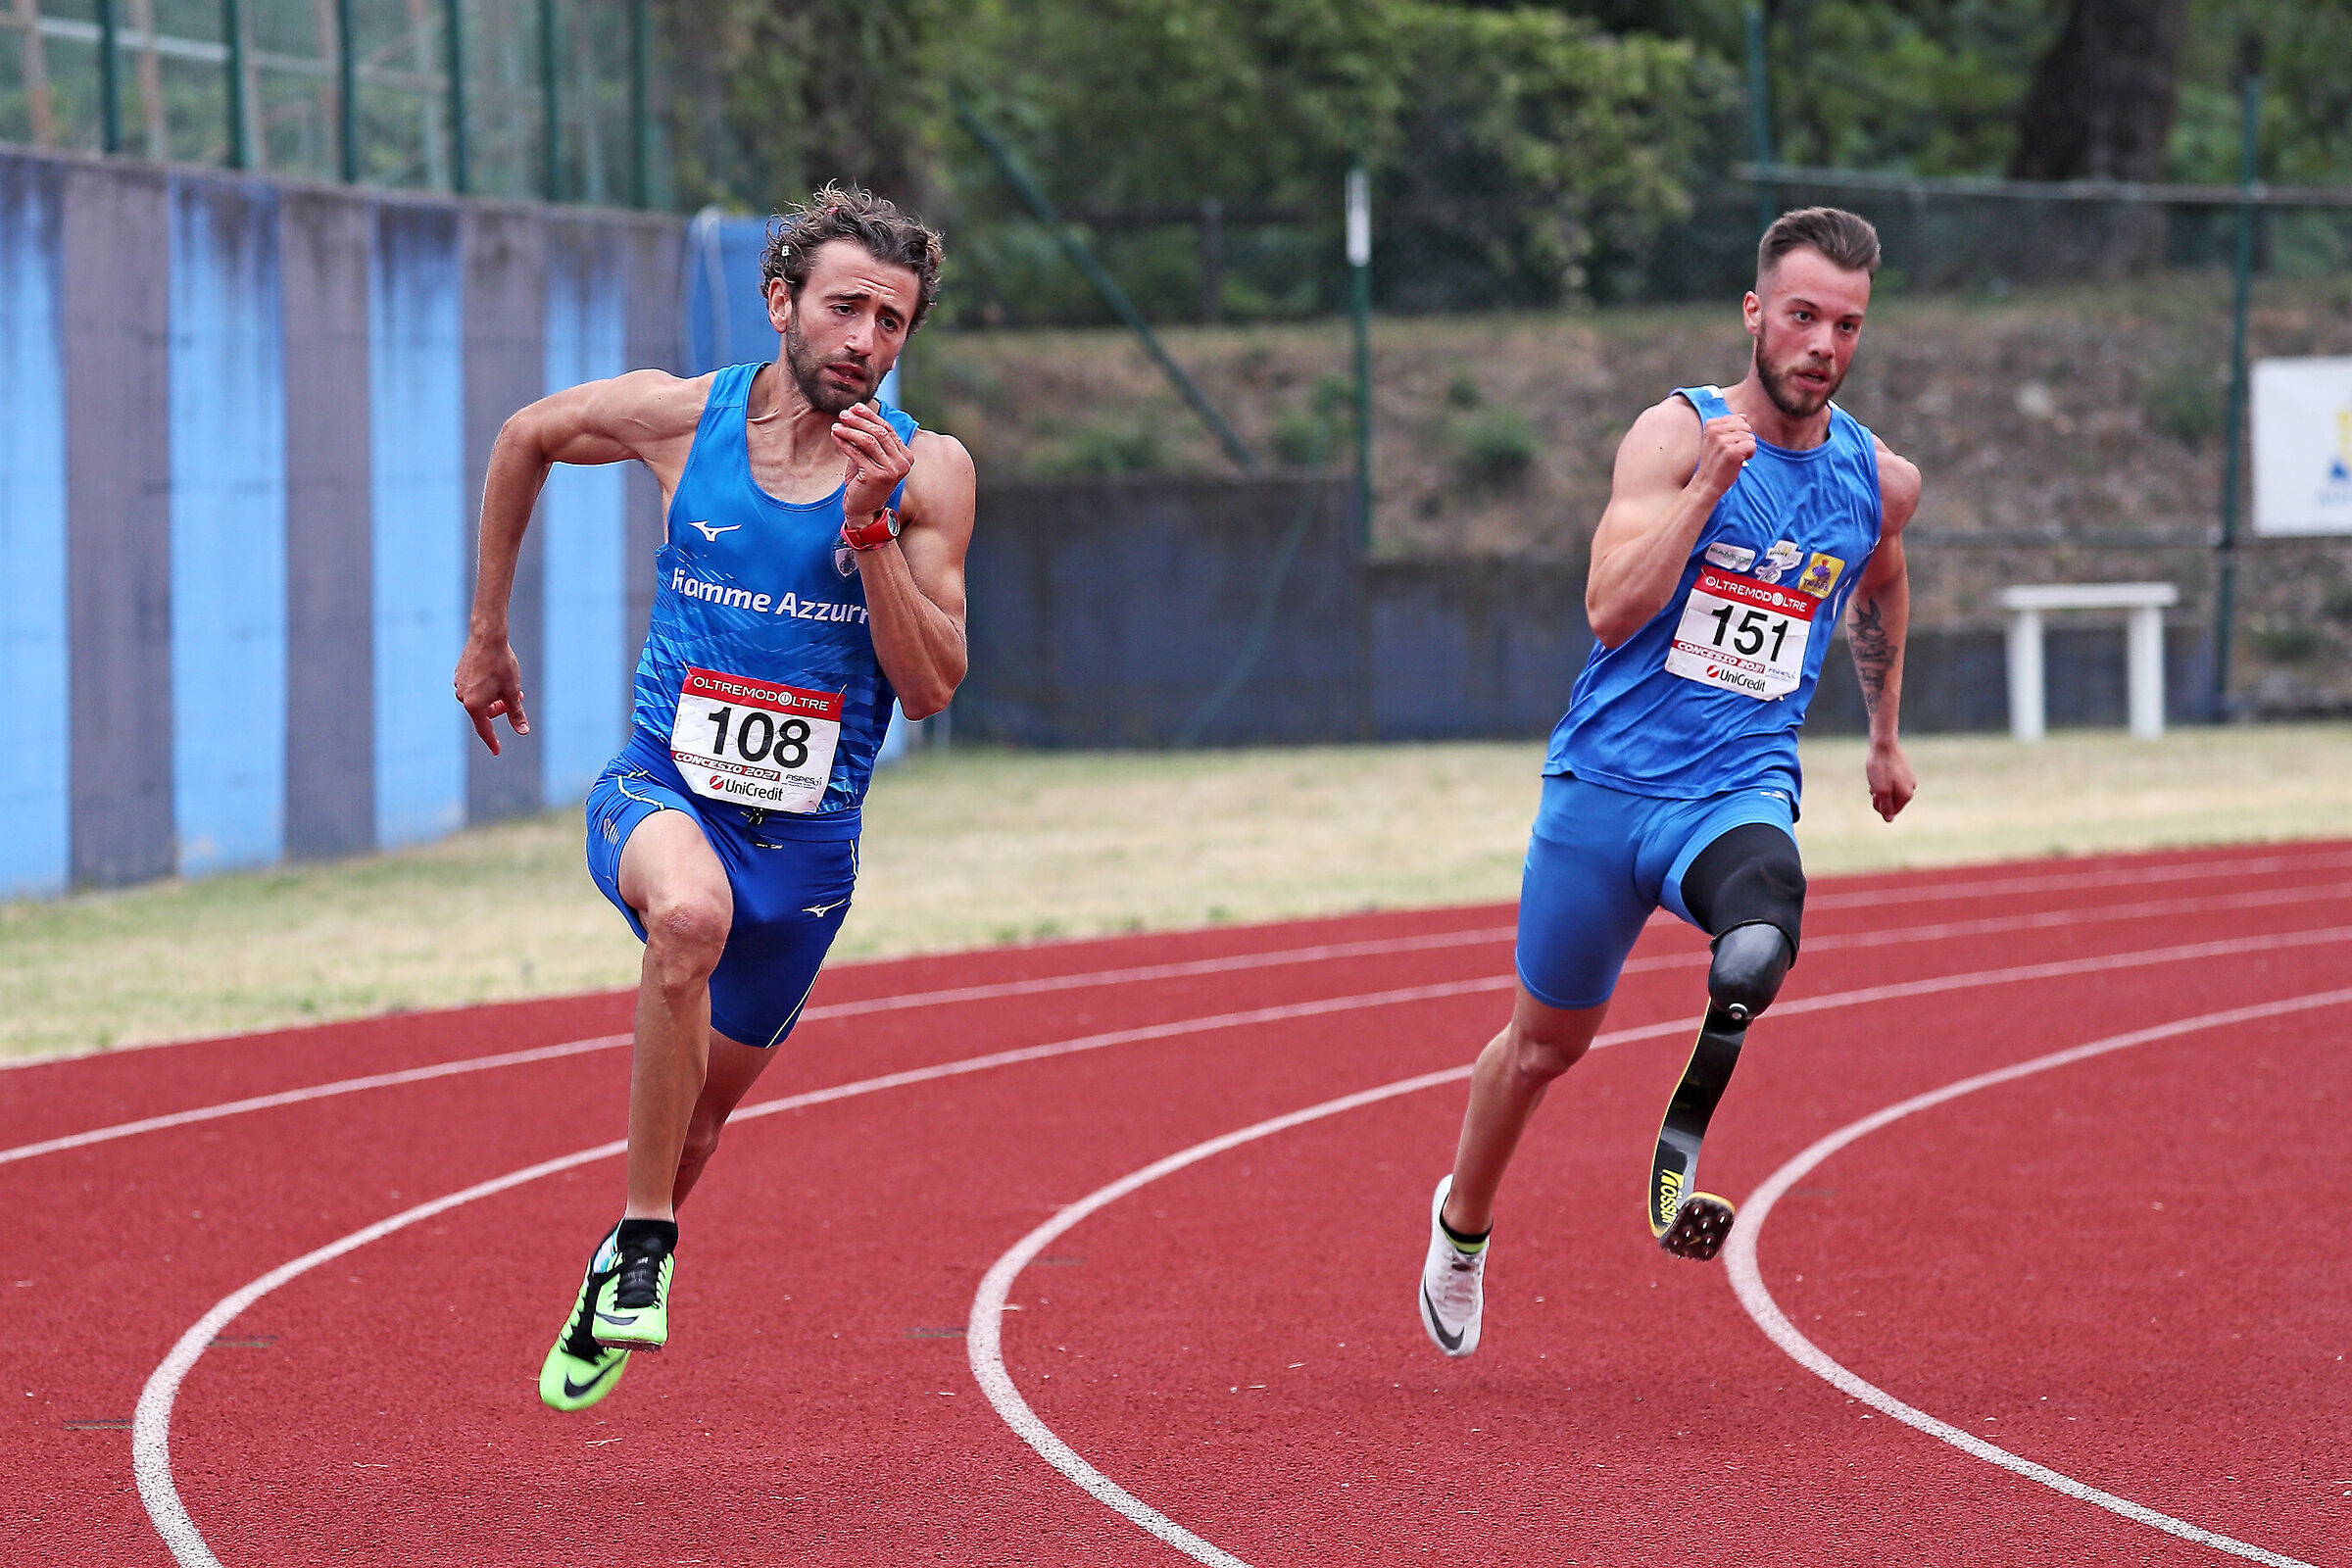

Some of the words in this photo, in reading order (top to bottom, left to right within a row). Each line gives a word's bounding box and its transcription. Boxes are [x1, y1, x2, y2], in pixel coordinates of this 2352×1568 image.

[774, 592, 869, 624] Azzurr
[1711, 604, 1789, 663] 151
[1677, 641, 1738, 666] CONCESIO
[1720, 668, 1766, 692] UniCredit
[708, 706, 811, 769] 108
[675, 753, 743, 774] CONCESIO
[744, 767, 780, 781] 2021
[725, 778, 784, 802] UniCredit
